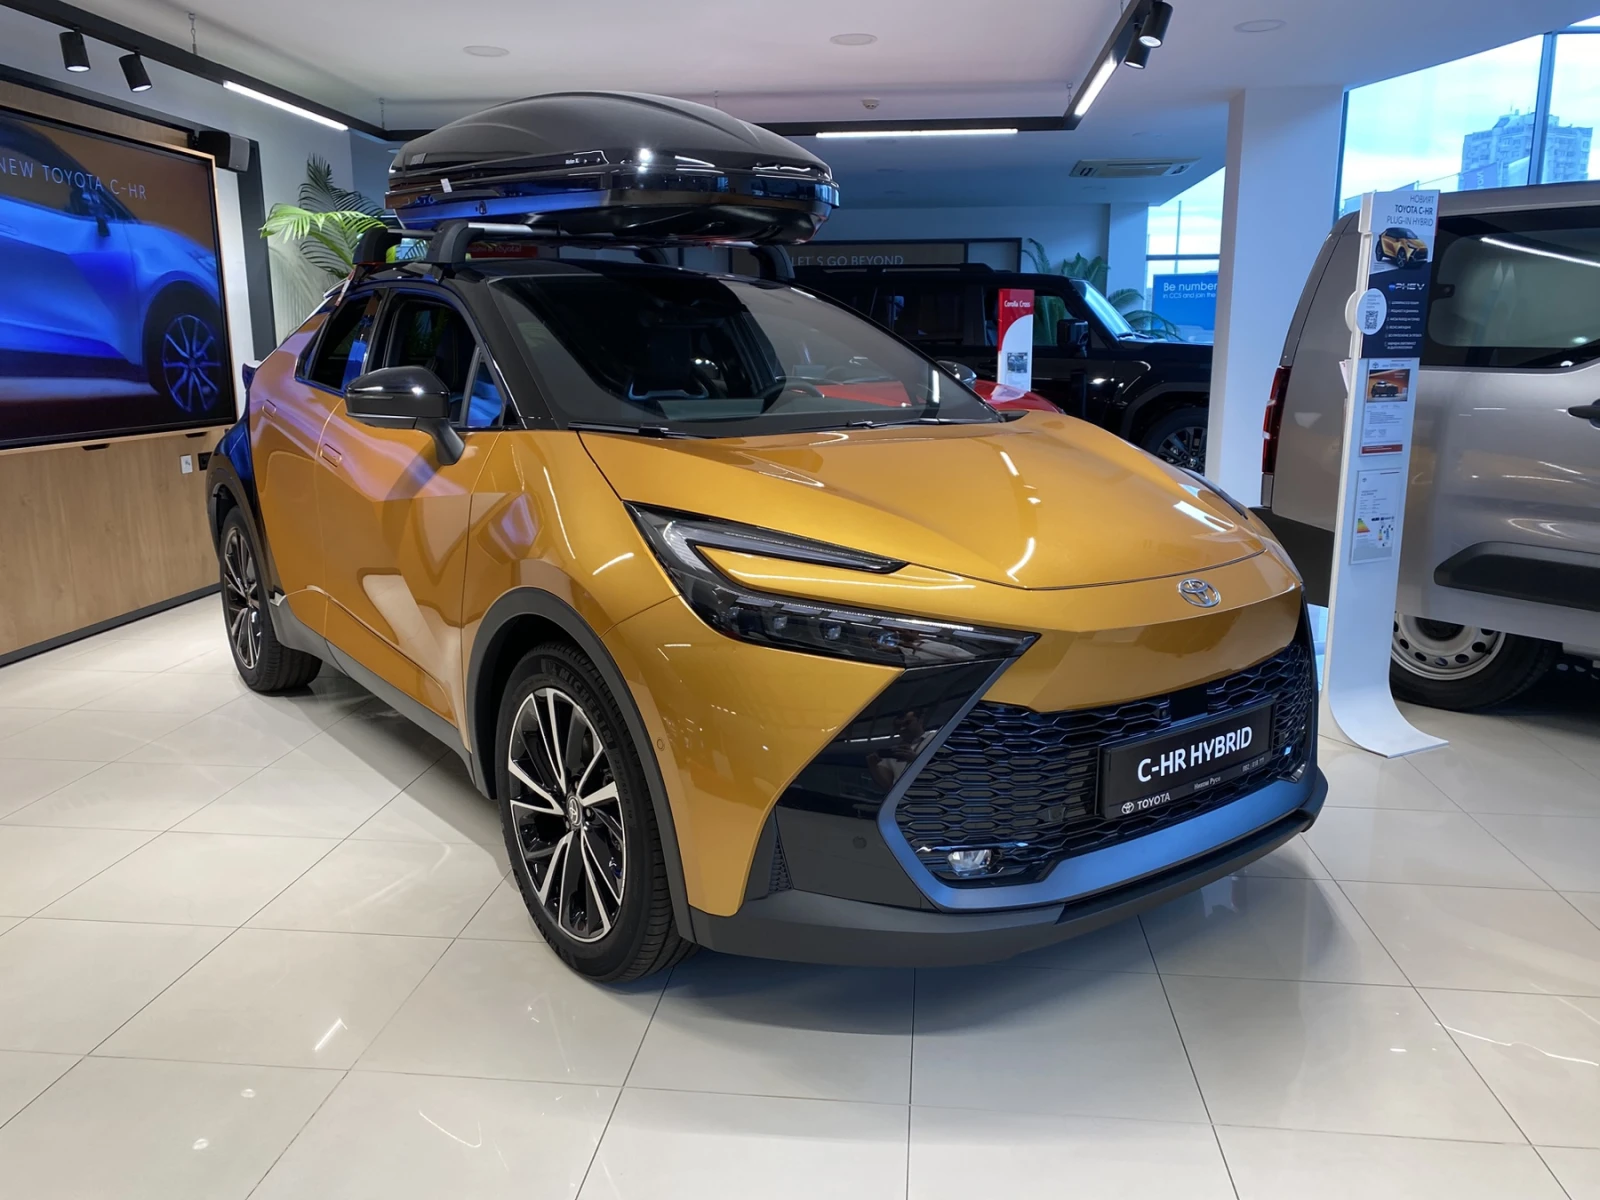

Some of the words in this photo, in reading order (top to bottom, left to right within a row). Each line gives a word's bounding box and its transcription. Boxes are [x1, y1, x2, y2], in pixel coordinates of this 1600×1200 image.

[0, 157, 34, 179] NEW
[42, 163, 105, 192] TOYOTA
[110, 178, 147, 200] C-HR
[1395, 204, 1418, 214] TOYOTA
[1418, 206, 1434, 215] C-HR
[1386, 215, 1412, 225] PLUG-IN
[1412, 217, 1434, 227] HYBRID
[827, 255, 848, 266] GO
[851, 255, 904, 265] BEYOND
[1163, 281, 1176, 292] Be
[1178, 281, 1218, 292] number
[1395, 282, 1425, 291] PHEV
[1004, 300, 1018, 308] Corolla
[1019, 300, 1031, 308] Cross
[558, 667, 614, 744] MICHELIN
[1137, 748, 1186, 783] C-HR
[1190, 726, 1253, 767] HYBRID
[1137, 792, 1171, 810] TOYOTA
